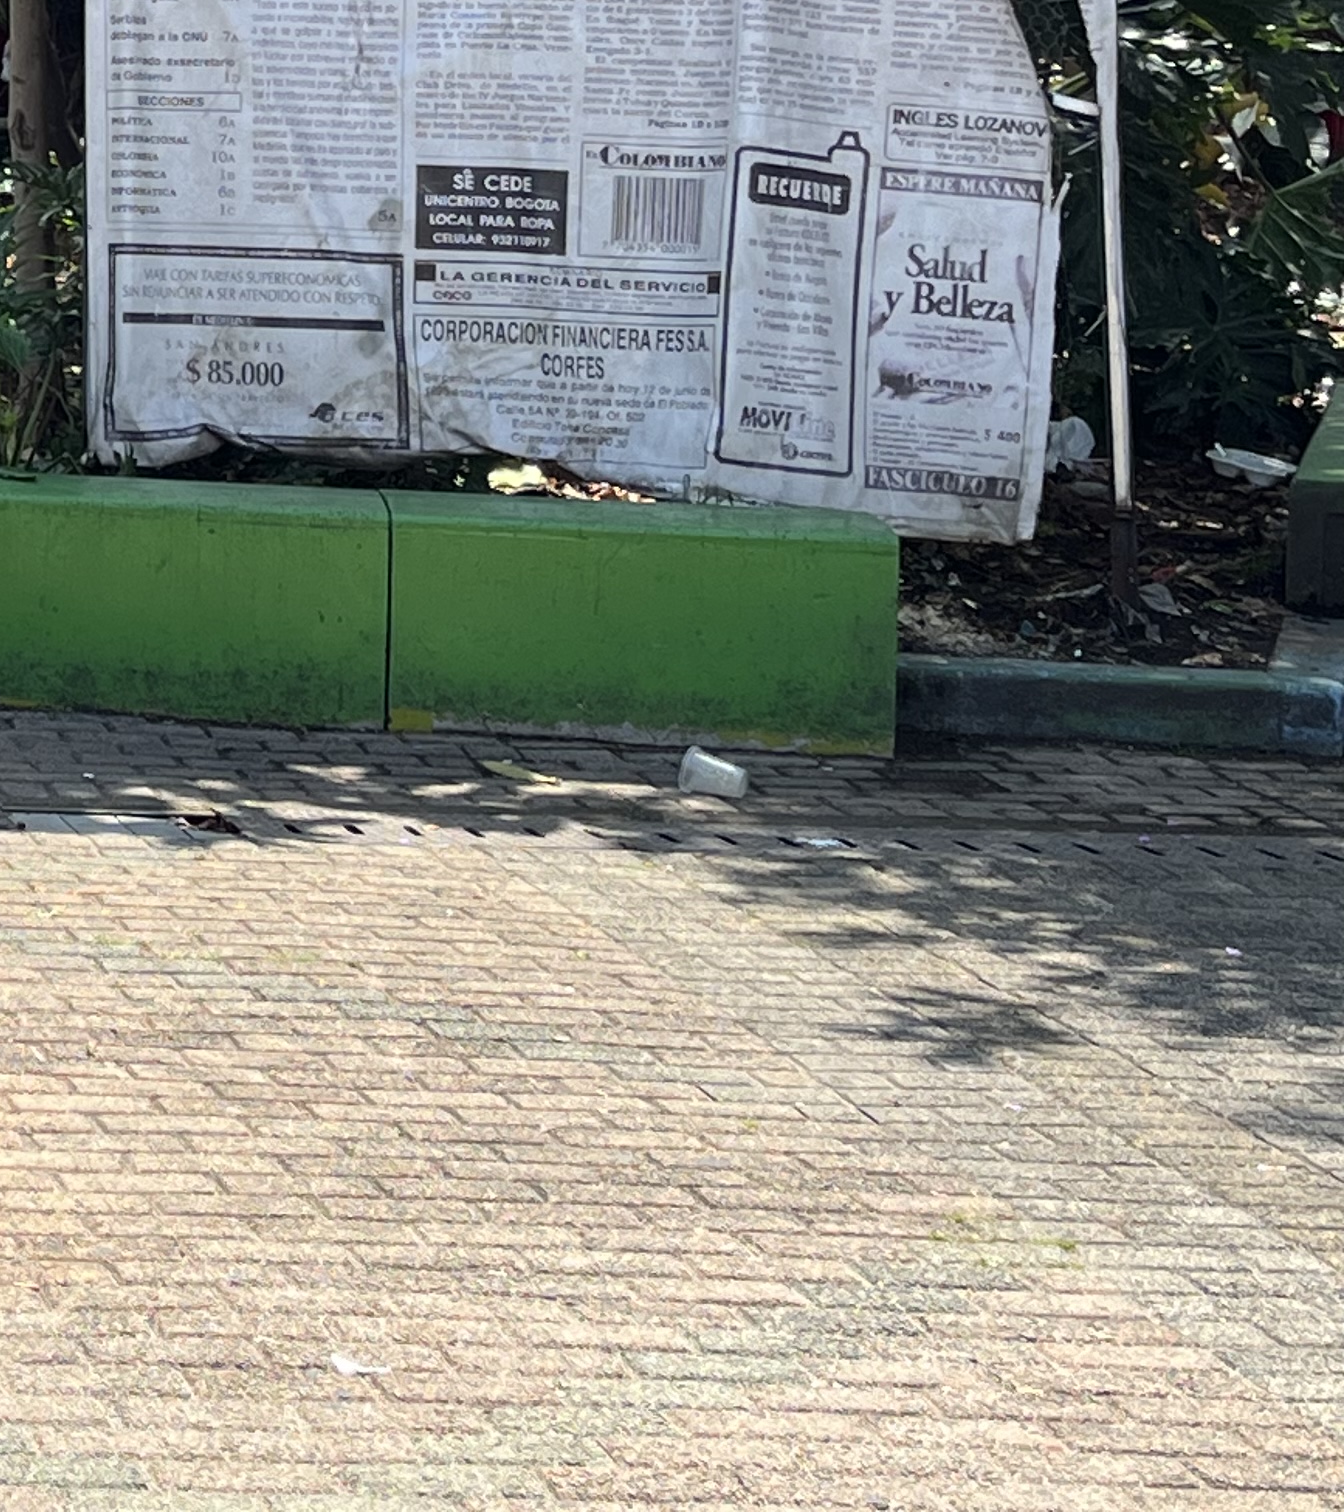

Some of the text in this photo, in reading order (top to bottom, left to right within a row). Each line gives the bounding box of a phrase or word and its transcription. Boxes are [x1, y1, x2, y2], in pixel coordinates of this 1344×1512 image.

[892, 109, 1048, 138] INGLES LOZANOV
[599, 145, 727, 169] COLOMBIANO
[483, 174, 533, 193] CEDE
[757, 174, 842, 206] RECUERDE
[885, 173, 1039, 201] ESPERE MAÑANA
[504, 196, 561, 211] BOGOTA
[429, 213, 556, 230] LOCAL PARA ROPA
[169, 268, 200, 283] CON
[905, 243, 988, 283] Salud
[439, 270, 707, 294] LA GERENCIA DEL SERVICIO
[239, 288, 301, 303] ATENDIDO
[303, 291, 332, 305] CON
[883, 282, 1015, 324] y Belleza
[420, 319, 550, 346] CORPORACION
[551, 324, 652, 351] FINANCIERA
[655, 330, 686, 353] FES
[186, 357, 285, 387] $ 85.000
[540, 353, 606, 380] CORFES
[868, 466, 1017, 498] FASCICULO 16
